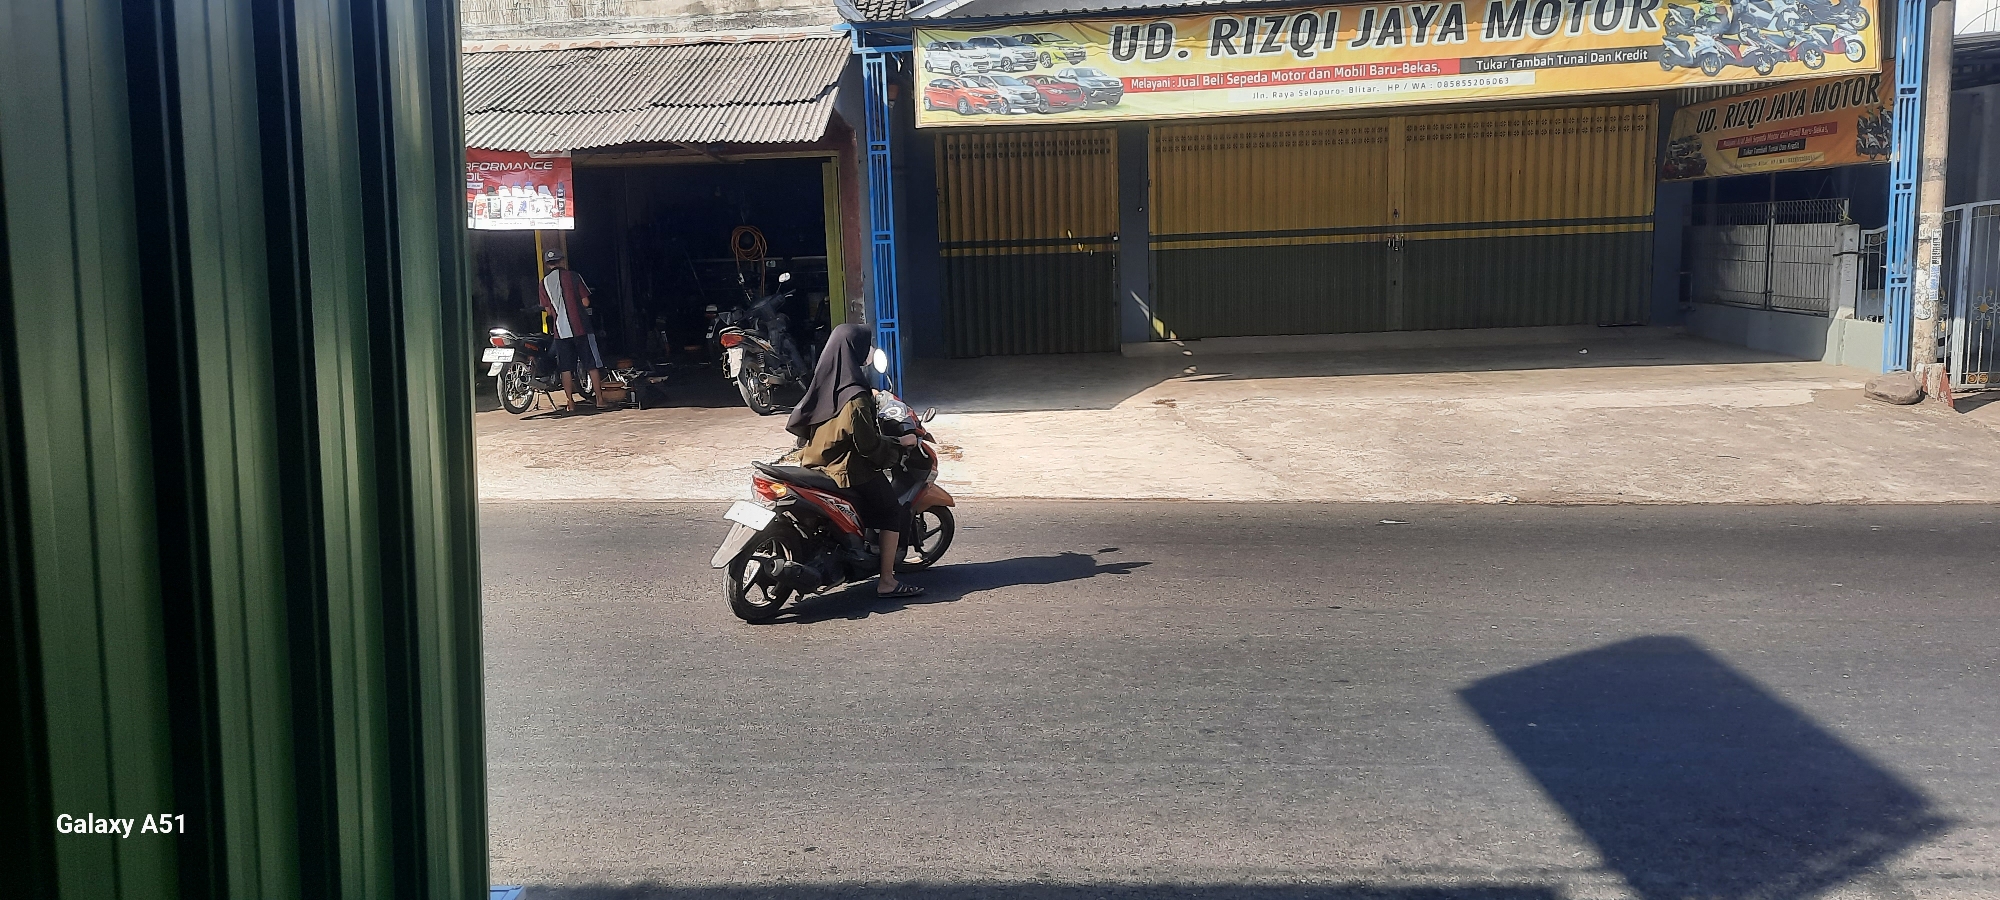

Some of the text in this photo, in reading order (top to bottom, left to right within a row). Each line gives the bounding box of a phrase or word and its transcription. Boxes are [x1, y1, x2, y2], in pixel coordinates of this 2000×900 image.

[1111, 0, 1657, 62] UD. RIZQI JAYA MOTOR
[1476, 49, 1648, 71] Tukar Tambah Tunai Dan Kredit
[1131, 78, 1171, 91] Melayani
[1177, 75, 1200, 88] Jual
[1202, 74, 1224, 86] Beli
[1226, 72, 1268, 87] Sepeda
[1271, 70, 1307, 82] Motor
[1308, 67, 1331, 79] dan
[1334, 65, 1366, 78] Mobil
[1369, 61, 1441, 76] Baru-Bekas,
[1272, 90, 1295, 99] Raya
[1348, 84, 1380, 94] Blitar.
[1411, 82, 1426, 90] WA
[1696, 74, 1880, 134] UD. RIZQI JAYA MOTOR
